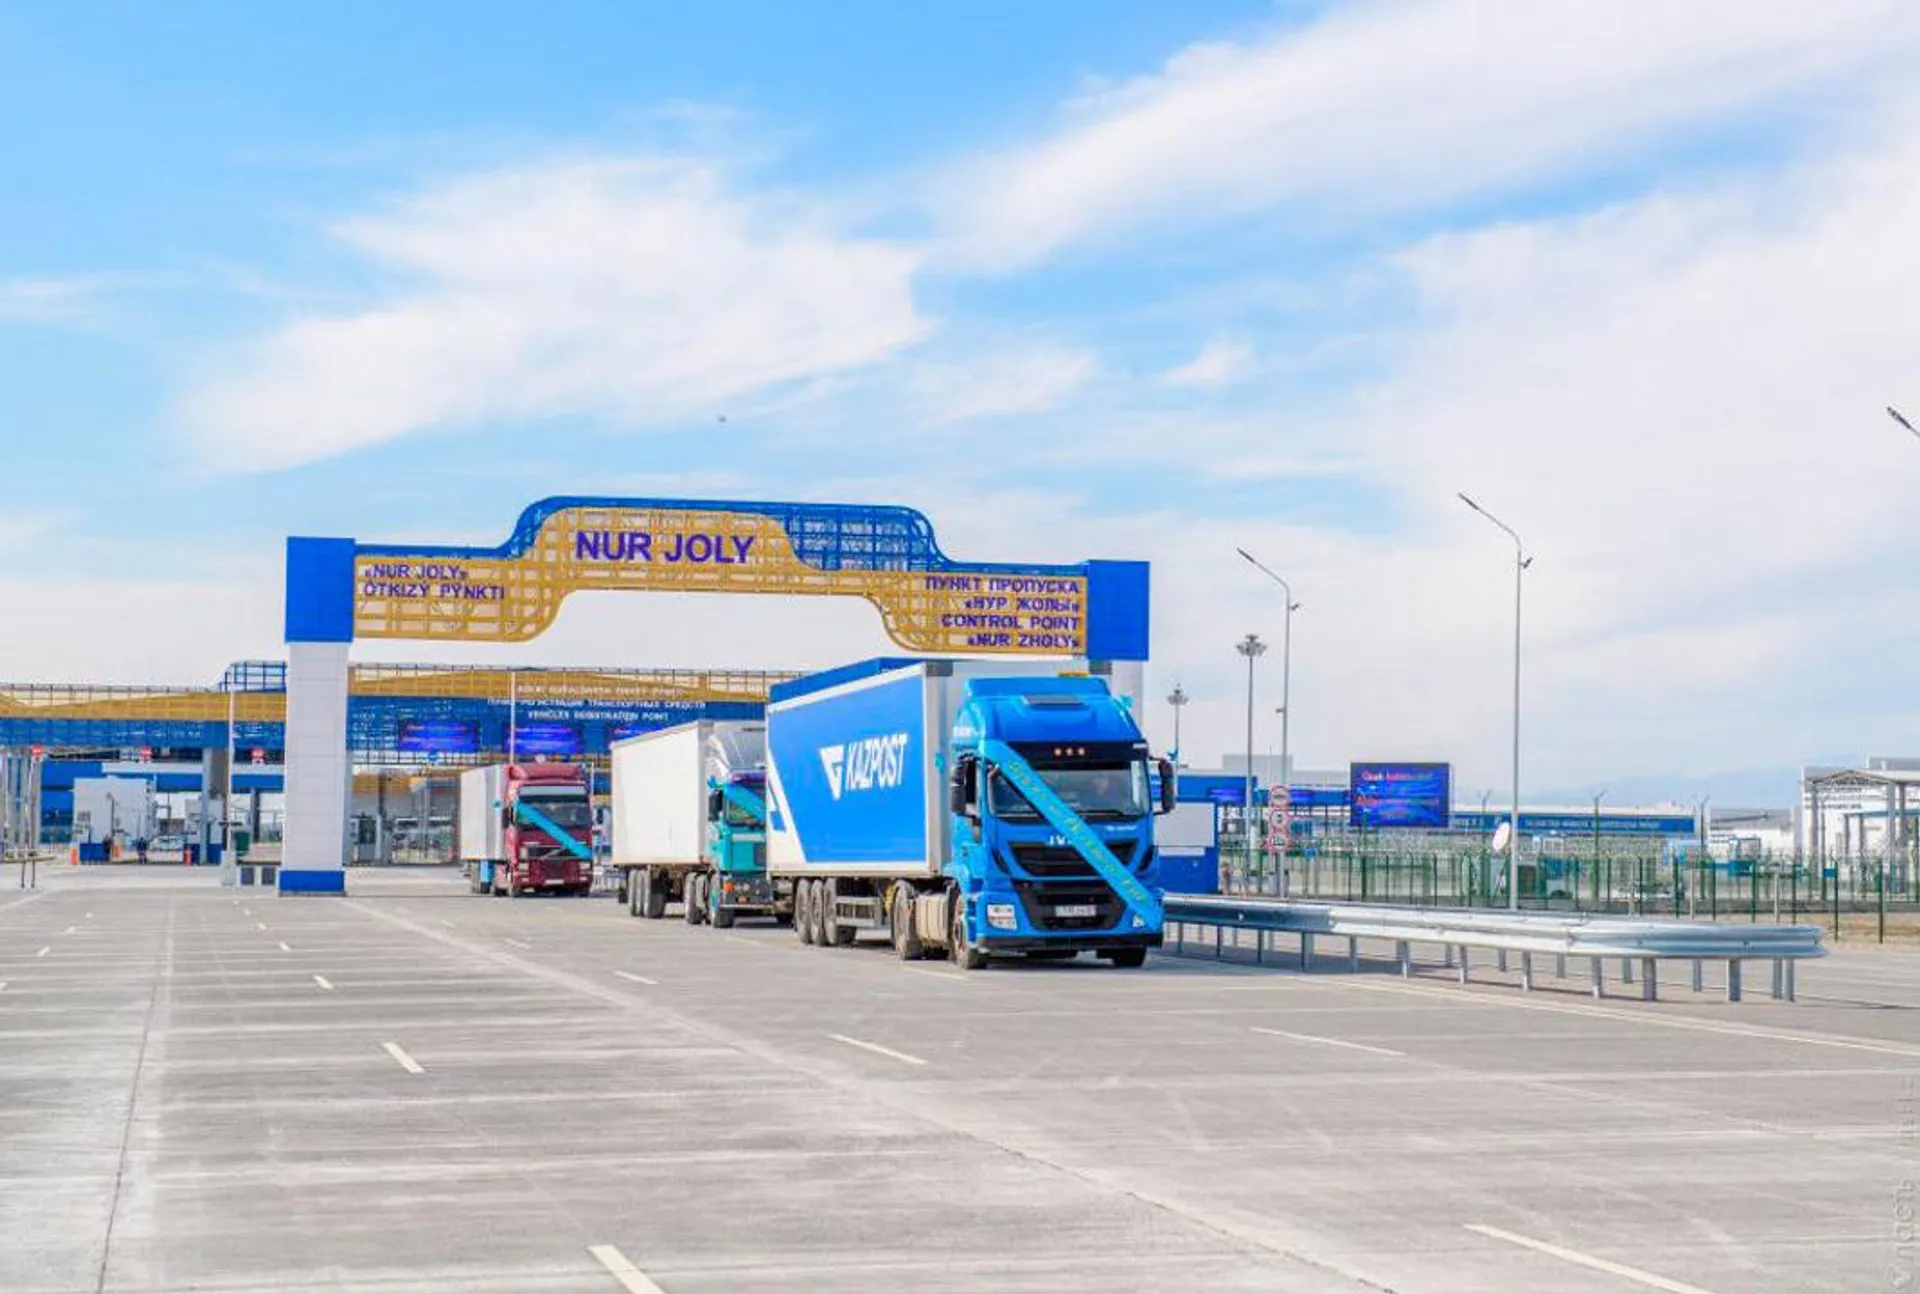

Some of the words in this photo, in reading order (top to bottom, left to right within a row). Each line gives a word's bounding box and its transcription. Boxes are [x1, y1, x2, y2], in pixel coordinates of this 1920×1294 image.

[576, 530, 652, 561] NUR
[664, 532, 755, 564] JOLY
[925, 575, 981, 591] ПУНКТ
[989, 577, 1080, 593] ПРОПУСКА
[941, 613, 1022, 628] CONTROL
[1030, 616, 1080, 630] POINT
[844, 732, 909, 792] KAZPOST
